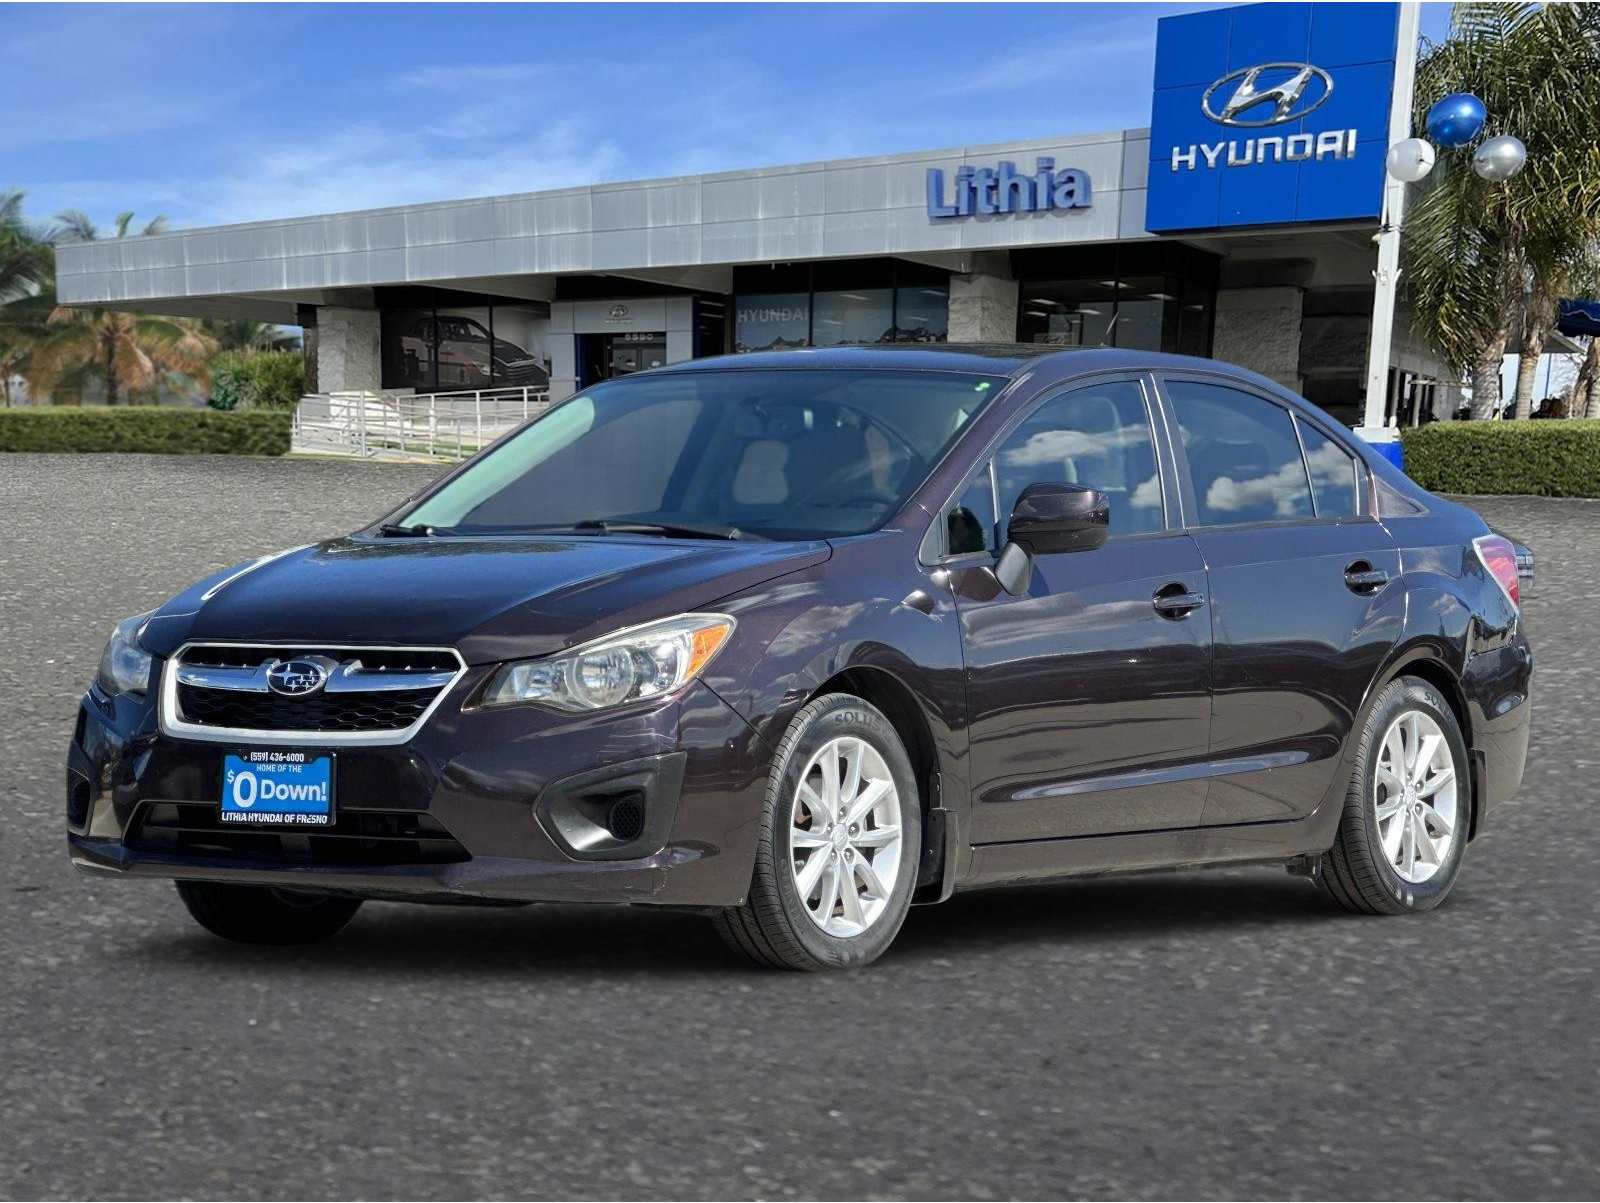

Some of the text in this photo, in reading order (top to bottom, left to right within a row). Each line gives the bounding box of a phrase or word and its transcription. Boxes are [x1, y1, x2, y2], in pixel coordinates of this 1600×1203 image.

[1171, 129, 1357, 172] HYUNDAI
[926, 157, 1092, 219] Lithia
[736, 308, 810, 323] HYUNDAI
[269, 753, 305, 763] 436-6000
[256, 764, 302, 773] HOME OF THE
[260, 779, 327, 802] Down!
[221, 812, 328, 825] LITHIA HYUNDAI OF FRESNO
